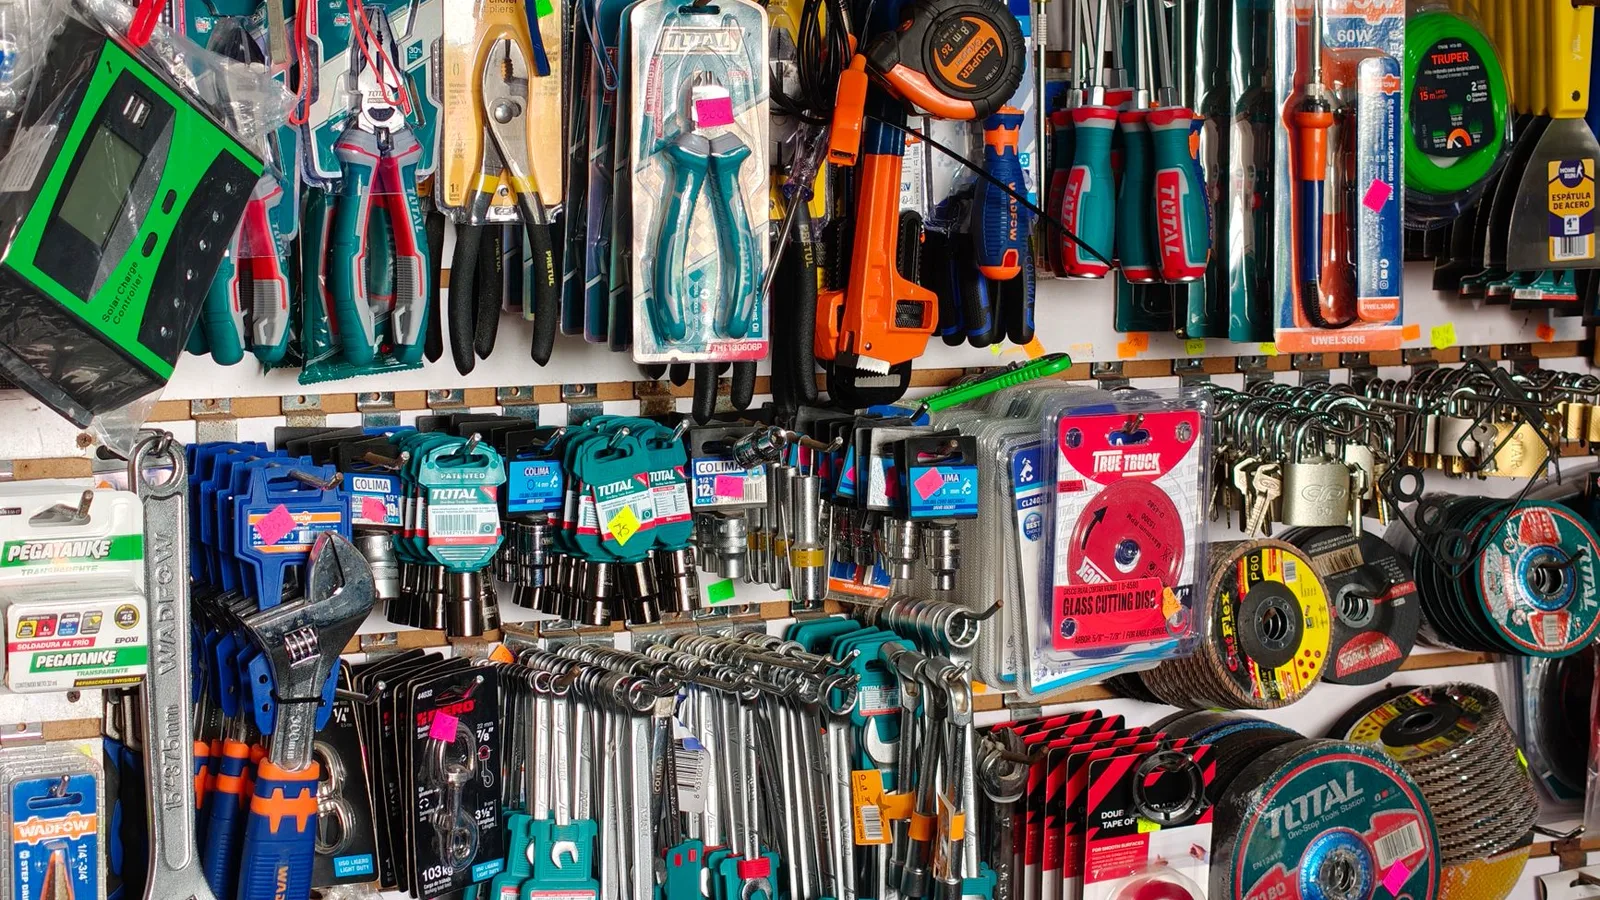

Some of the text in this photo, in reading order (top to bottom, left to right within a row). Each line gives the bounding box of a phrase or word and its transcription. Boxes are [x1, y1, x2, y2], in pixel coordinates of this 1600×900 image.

[668, 32, 730, 48] TOTAL
[1337, 29, 1373, 42] 60W
[960, 42, 995, 79] TRUPER
[1432, 52, 1470, 65] TRUPER
[1420, 92, 1428, 100] 15
[1552, 192, 1591, 201] ESPÁTULA
[407, 187, 423, 233] TOTAL
[1553, 201, 1589, 210] DE ACERO
[1161, 185, 1180, 256] TOTAL
[546, 250, 554, 286] PRETUL
[102, 262, 138, 322] Solar Charge
[112, 274, 144, 324] Controller
[1311, 335, 1365, 345] UWEL3606
[698, 462, 742, 473] COLIMA
[1092, 450, 1161, 477] TRUE TRUCK
[524, 467, 549, 476] COLIMA
[649, 469, 675, 482] TOTAL
[355, 479, 389, 490] COLIMA
[598, 479, 634, 497] TOTAL
[432, 489, 477, 499] TOTAL
[7, 540, 112, 562] PEGATANKE
[1250, 555, 1259, 580] P60
[154, 532, 175, 675] WADFOW
[1063, 589, 1156, 616] GLASS CUTTING DISC
[17, 641, 60, 650] SOLDADURA
[115, 636, 138, 644] EPOXI
[36, 650, 117, 668] PEGATANKE
[77, 668, 129, 676] TRANSPARENTE
[76, 678, 113, 686] REPARACIONES
[654, 756, 663, 792] COLIMA
[1263, 770, 1364, 838] TOTAL
[1101, 810, 1124, 819] DOUB
[1288, 796, 1366, 840] One-Stop Tools Station
[20, 820, 89, 837] WADFOW
[1102, 818, 1135, 829] TAPE OF
[1121, 840, 1144, 848] SURFACES
[21, 860, 29, 882] STEP
[357, 864, 369, 872] DUTY
[422, 866, 453, 881] 103 kg
